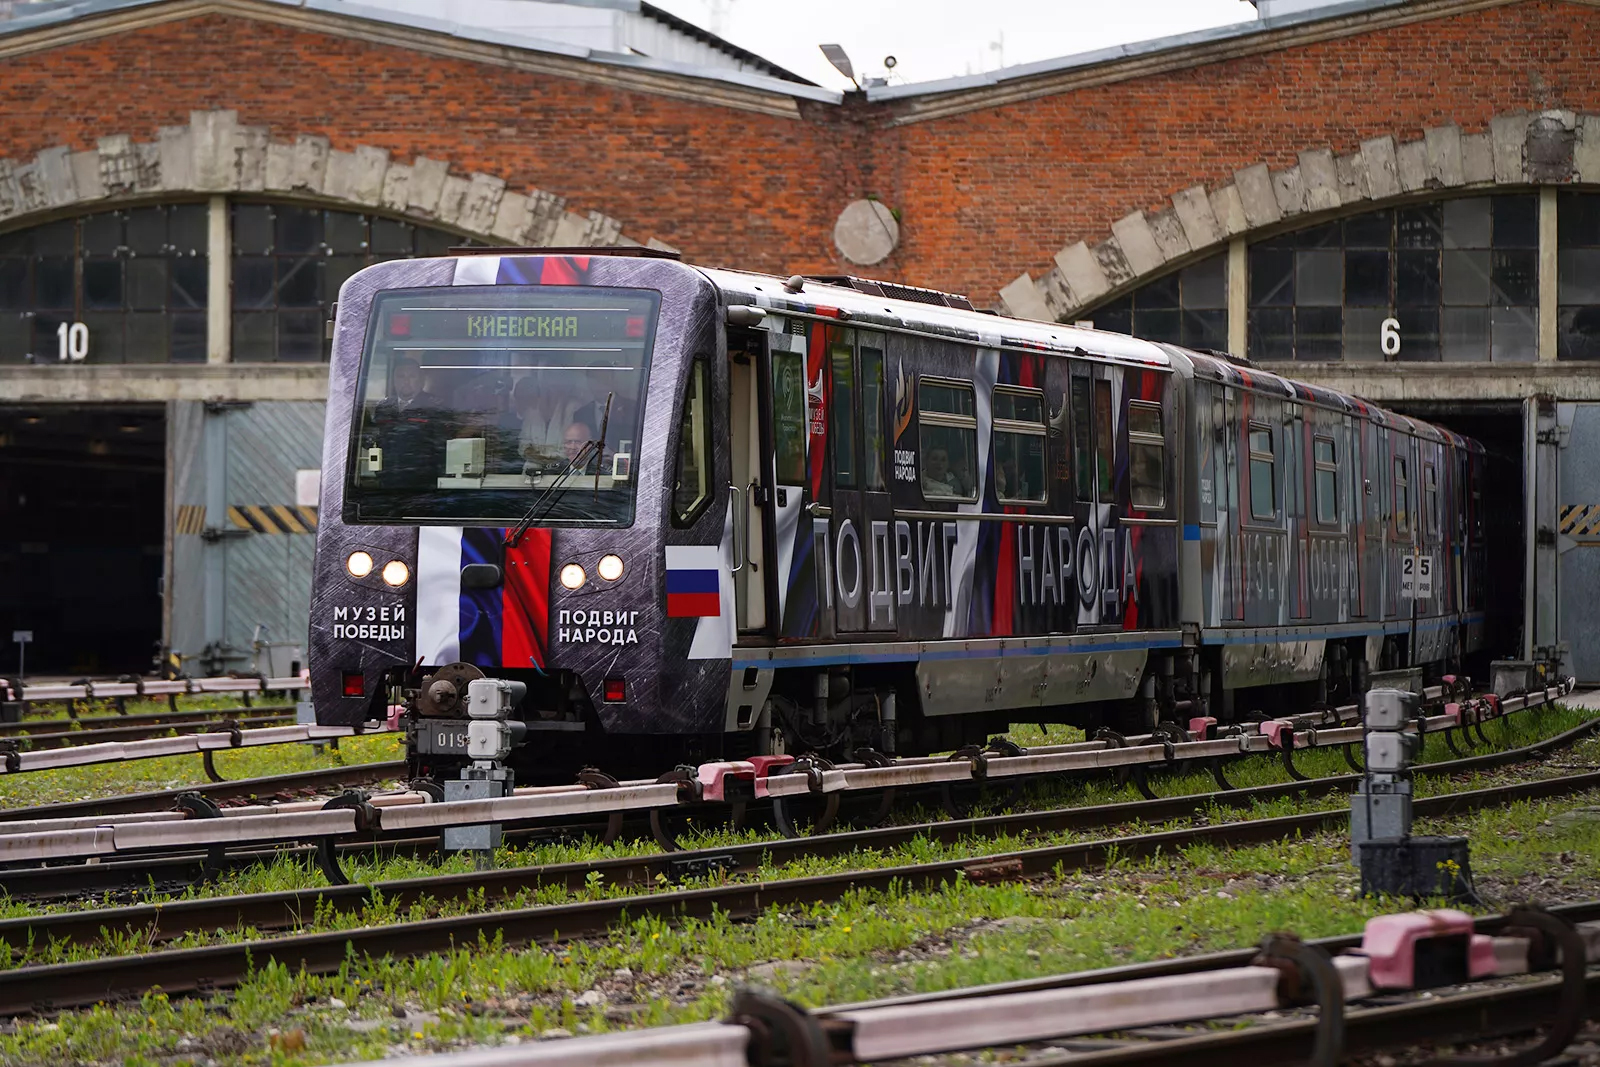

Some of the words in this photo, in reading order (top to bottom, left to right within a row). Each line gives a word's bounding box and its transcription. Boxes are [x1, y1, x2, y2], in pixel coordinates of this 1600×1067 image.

[467, 315, 577, 337] КИЕВСКАЯ
[57, 321, 88, 360] 10
[1381, 317, 1400, 355] 6
[895, 450, 915, 465] ПОДВИГ
[895, 465, 916, 482] НАРОДА
[813, 518, 957, 624] ПОДВИГ
[1018, 525, 1138, 617] НАРОДА
[334, 604, 405, 621] МУЗЕЙ
[559, 610, 639, 627] ПОДВИГ
[334, 624, 405, 641] ПОБЕДЫ
[559, 628, 638, 645] НАРОДА
